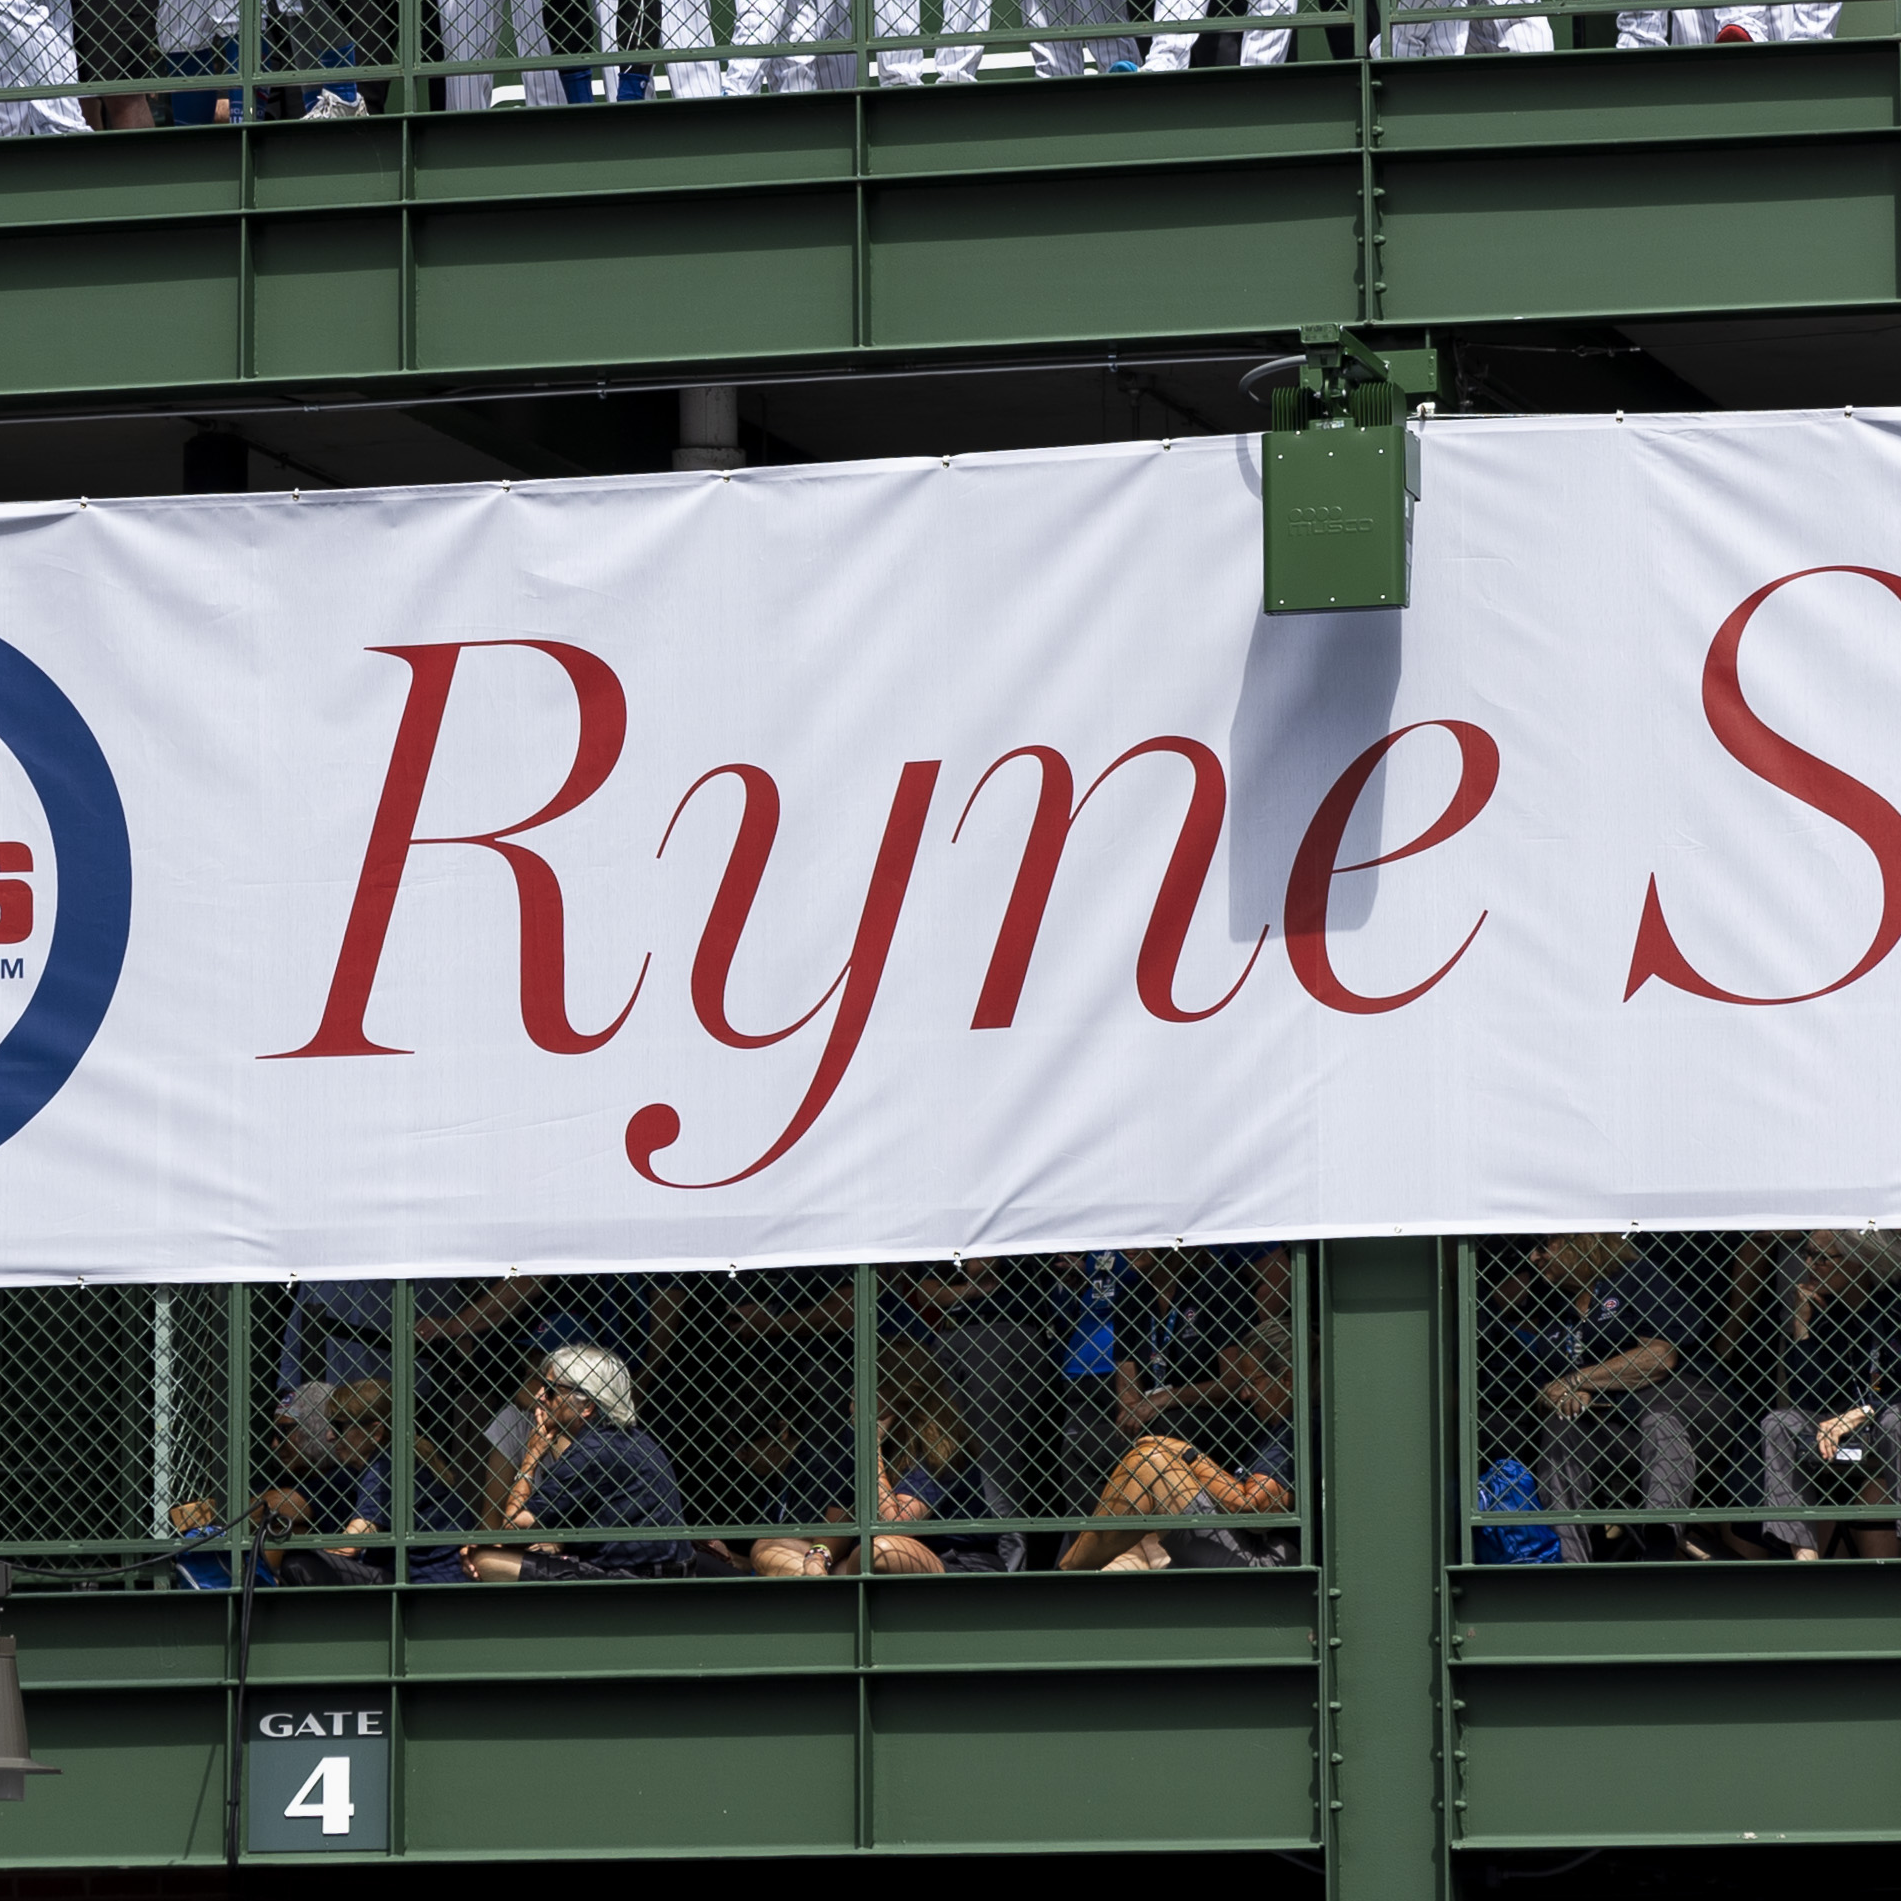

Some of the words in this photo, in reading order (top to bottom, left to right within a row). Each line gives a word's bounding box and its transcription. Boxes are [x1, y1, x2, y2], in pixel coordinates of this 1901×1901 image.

[254, 638, 1502, 1189] Ryne
[259, 1711, 383, 1738] GATE
[283, 1756, 355, 1835] 4
